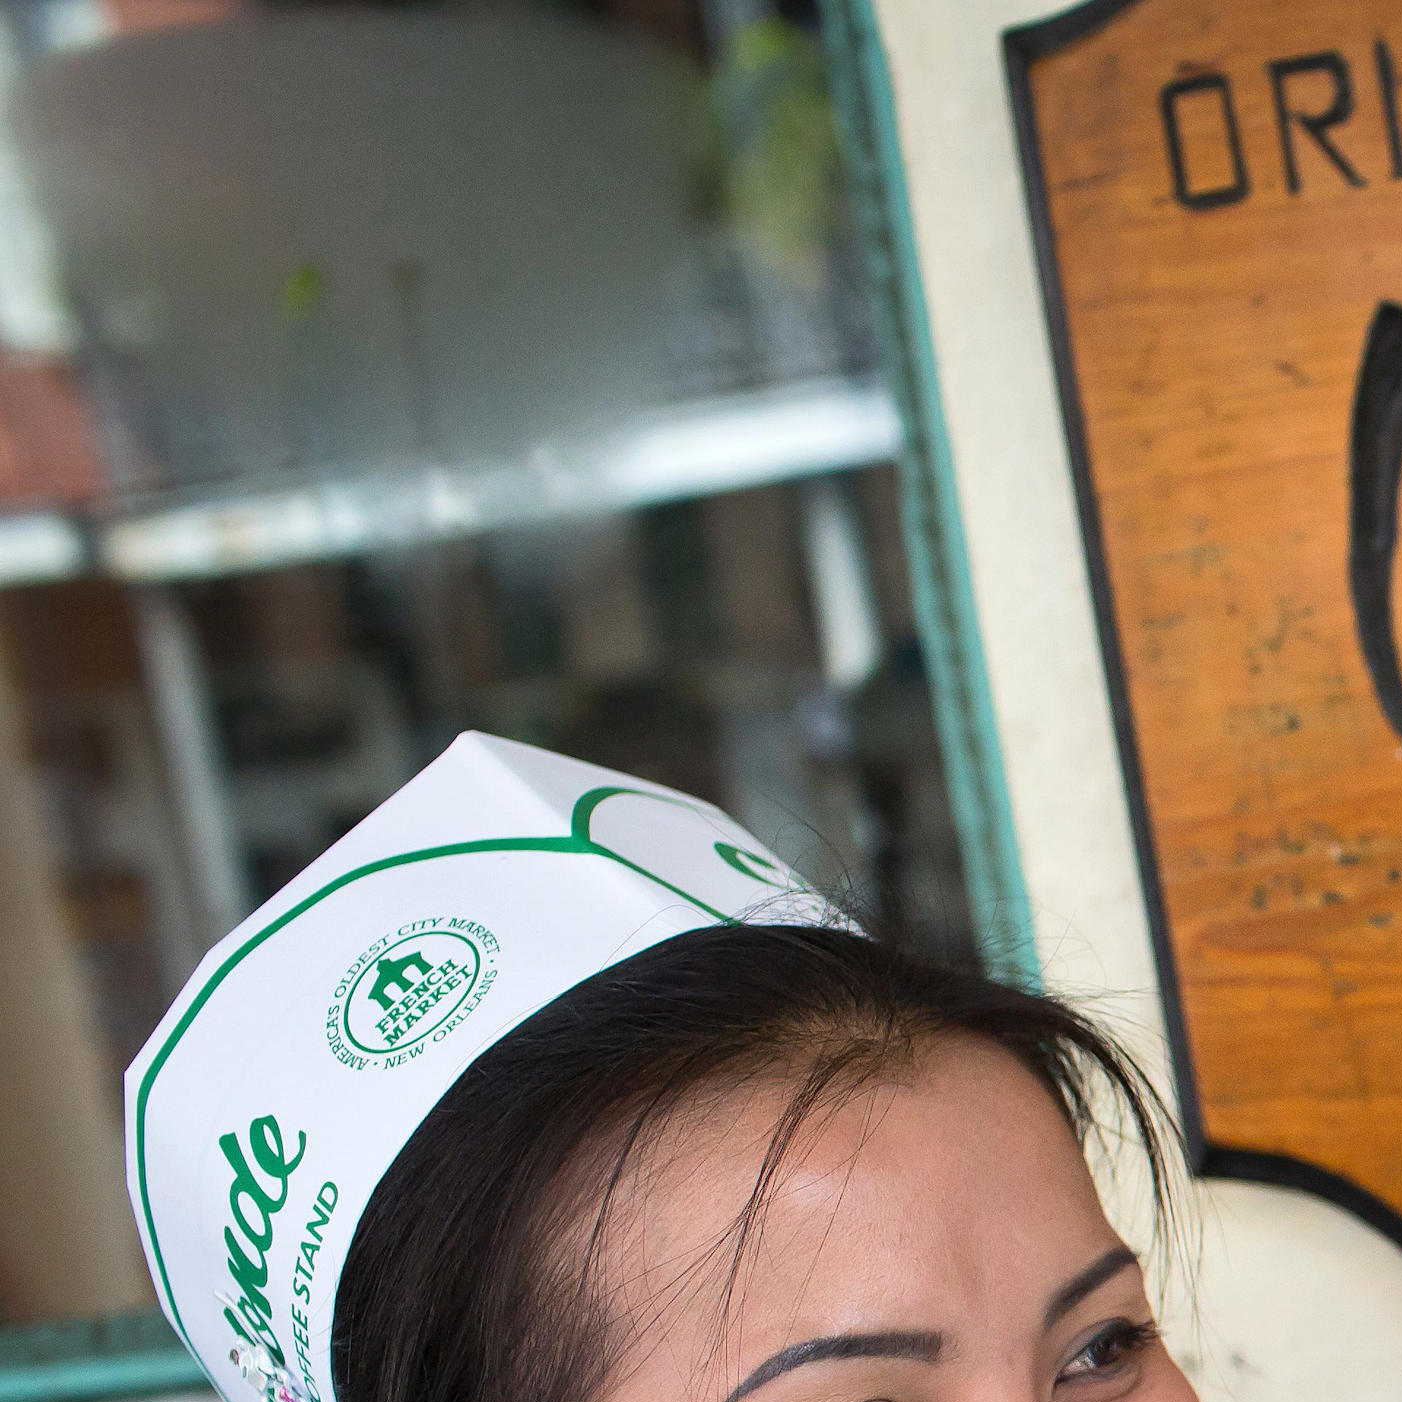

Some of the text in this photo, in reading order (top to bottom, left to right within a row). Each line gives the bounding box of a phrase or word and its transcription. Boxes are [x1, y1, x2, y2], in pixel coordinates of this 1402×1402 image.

[326, 917, 500, 1071] AMERICA'S OLDEST CITY MARKET
[375, 958, 459, 1035] FRENCH
[383, 964, 472, 1047] MARKET
[384, 969, 498, 1070] NEW ORLEANS
[292, 1180, 339, 1305] STAND
